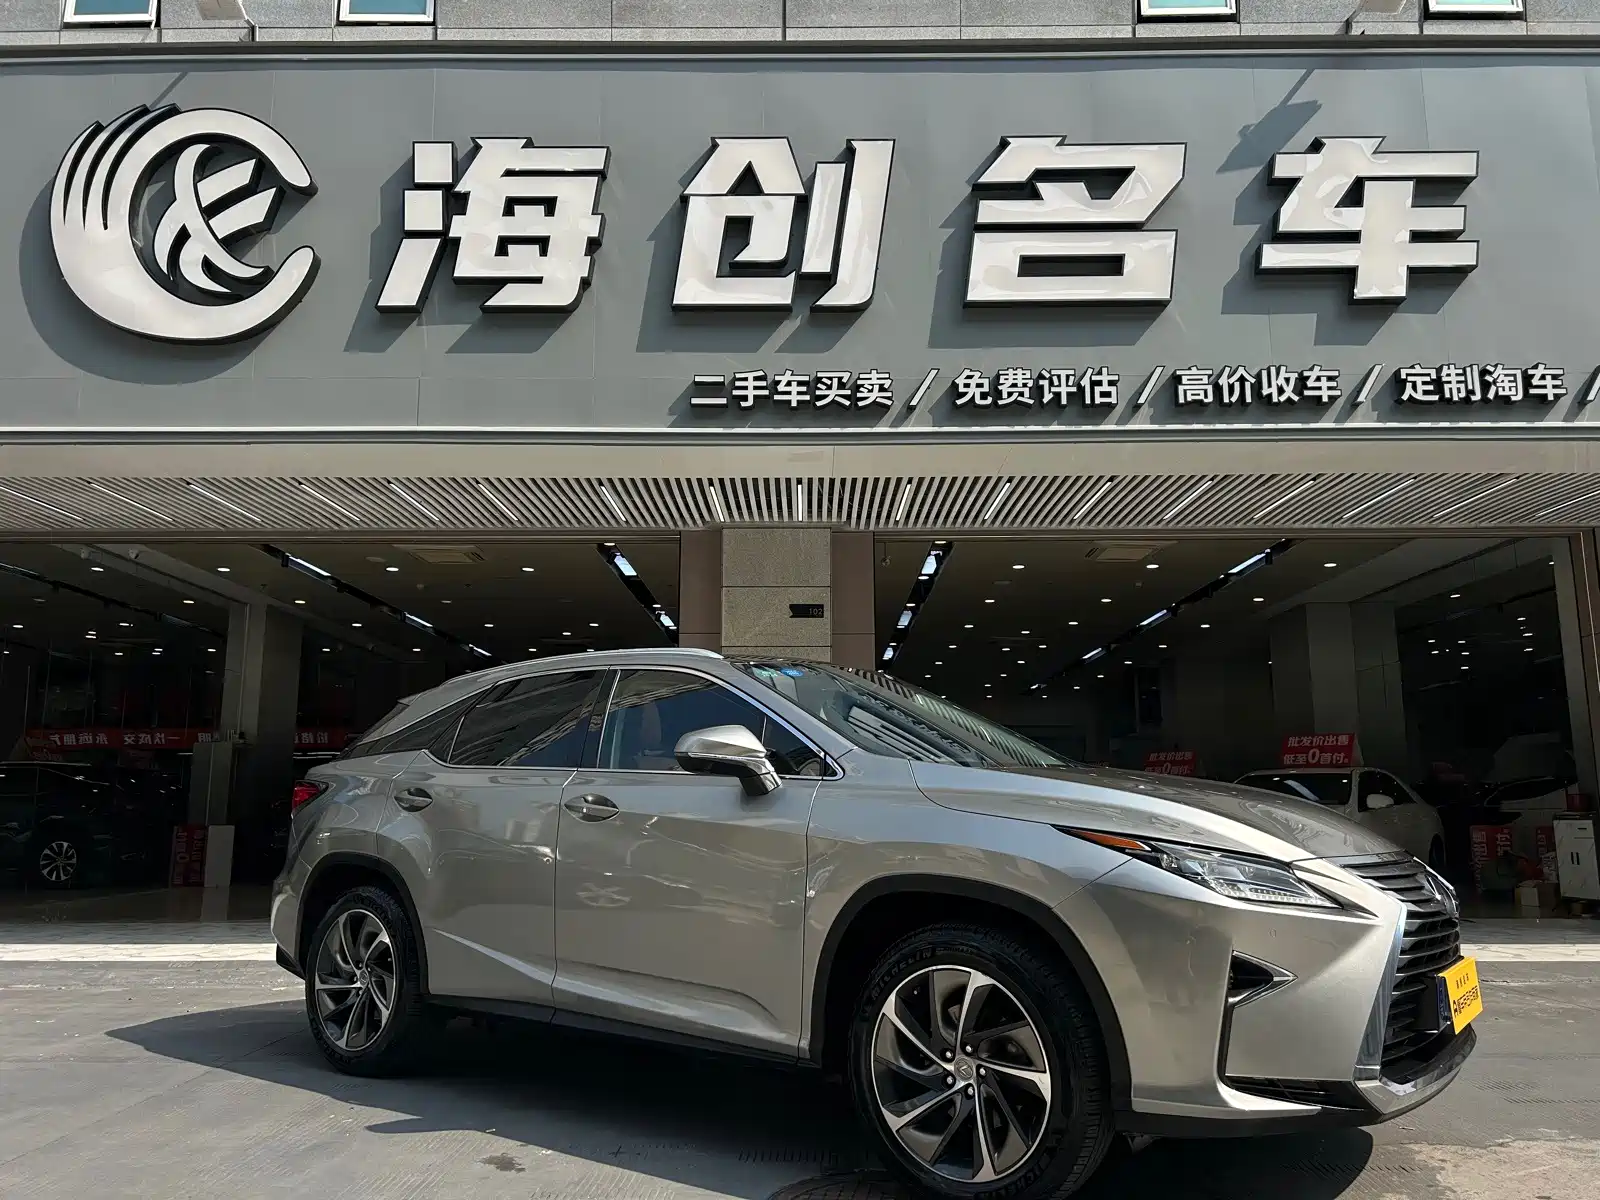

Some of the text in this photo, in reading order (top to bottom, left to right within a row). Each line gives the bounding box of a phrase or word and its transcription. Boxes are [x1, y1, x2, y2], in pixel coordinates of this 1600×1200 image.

[376, 136, 1480, 311] 海创名车
[690, 368, 894, 411] 二手车买卖
[954, 366, 1120, 410] 免费评估
[1175, 365, 1342, 407] 高价收车
[1398, 363, 1568, 405] 定制淘车
[1287, 734, 1349, 747] 批发价出售
